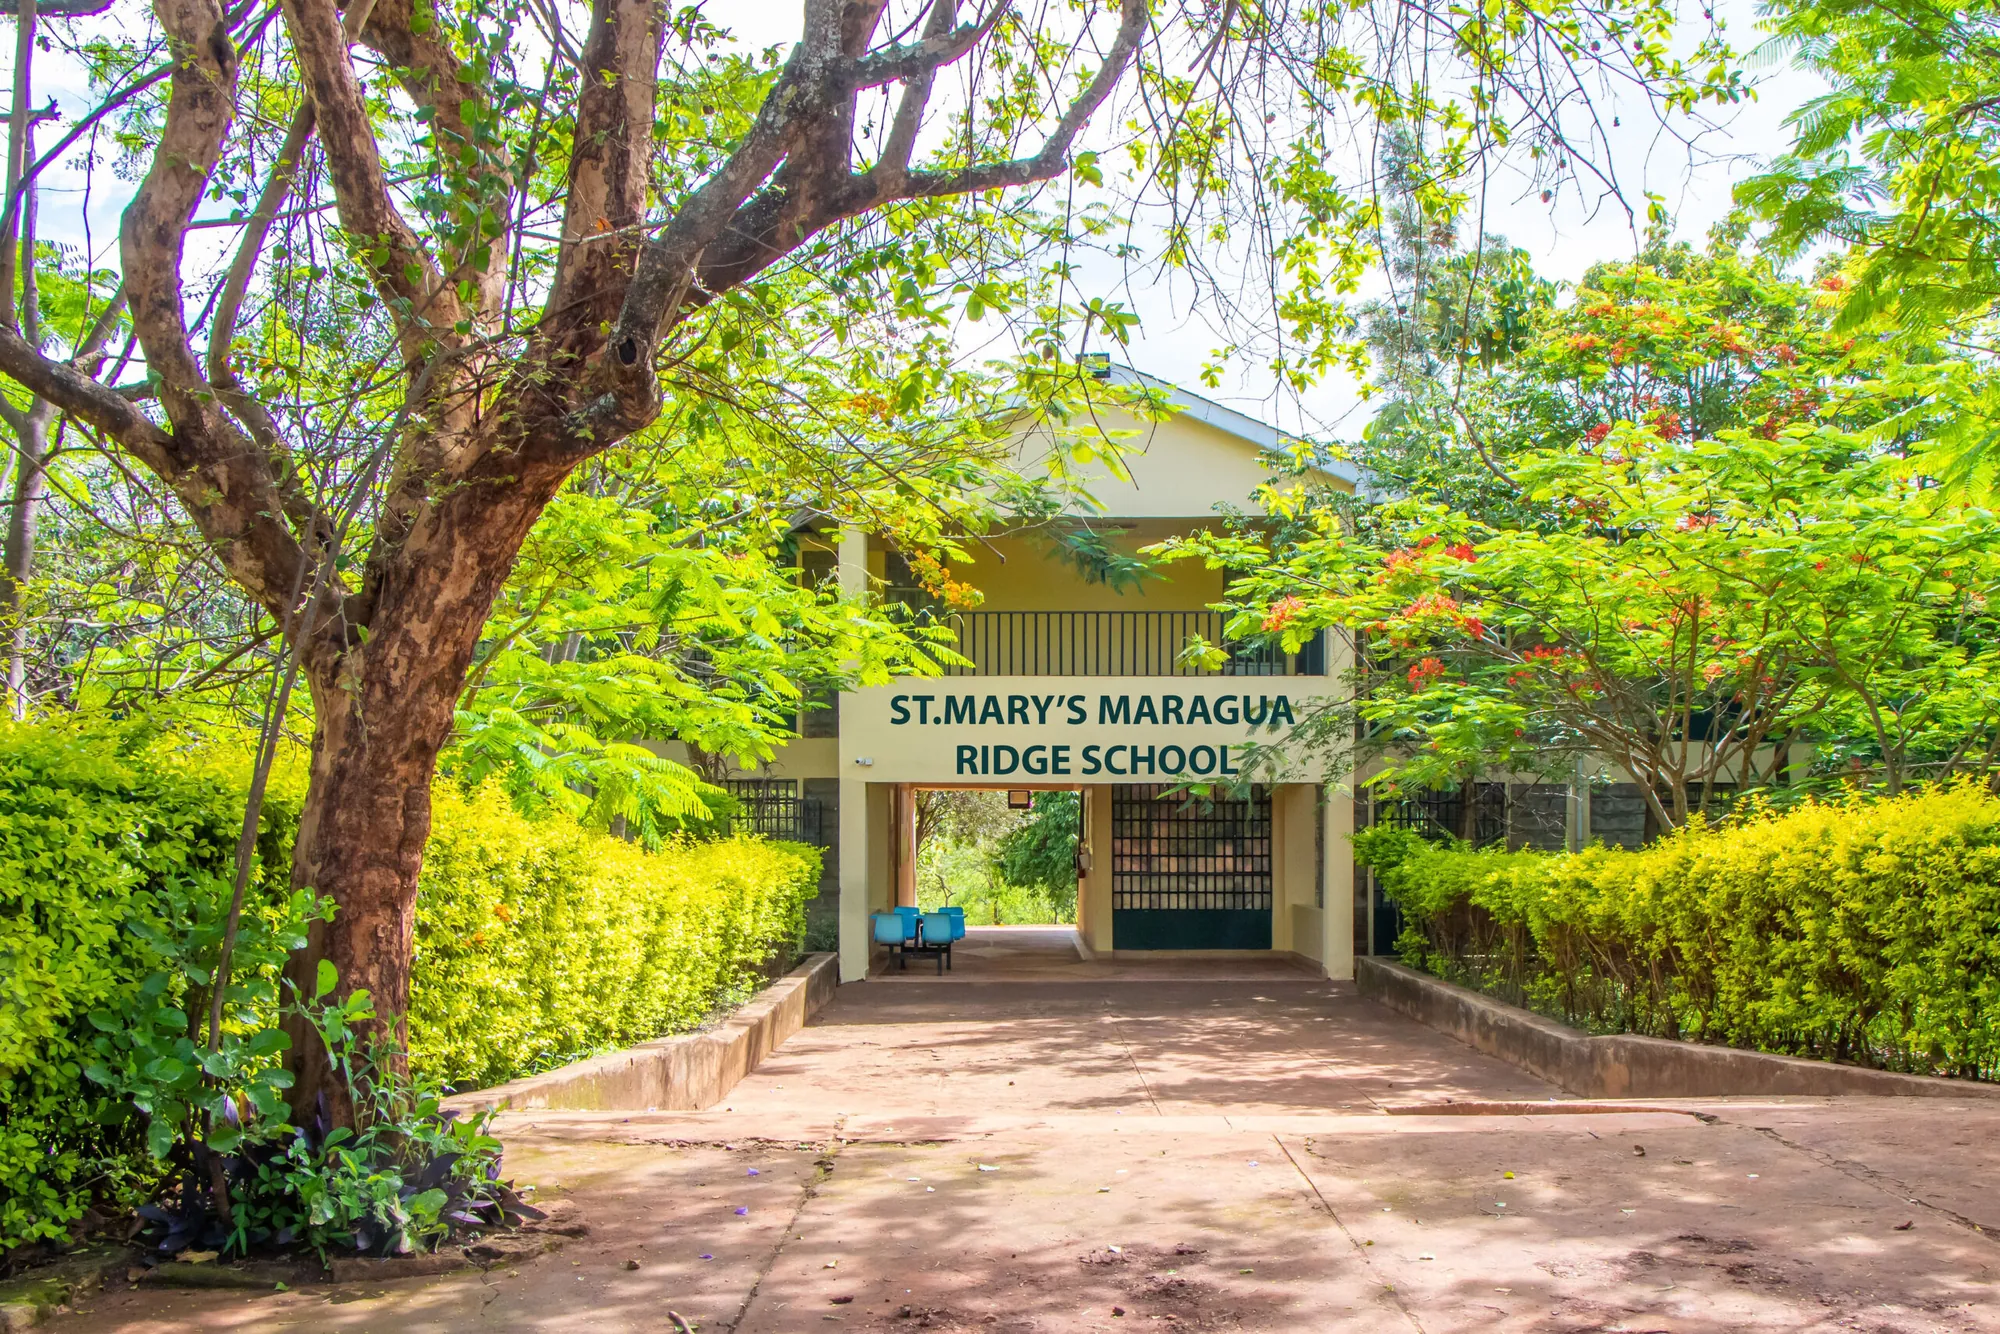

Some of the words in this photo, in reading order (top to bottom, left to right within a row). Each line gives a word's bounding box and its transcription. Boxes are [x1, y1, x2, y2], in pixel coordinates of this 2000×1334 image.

[890, 694, 1087, 725] ST.MARY’S
[1098, 695, 1295, 725] MARAGUA
[956, 745, 1071, 775] RIDGE
[1081, 744, 1239, 776] SCHOOL
